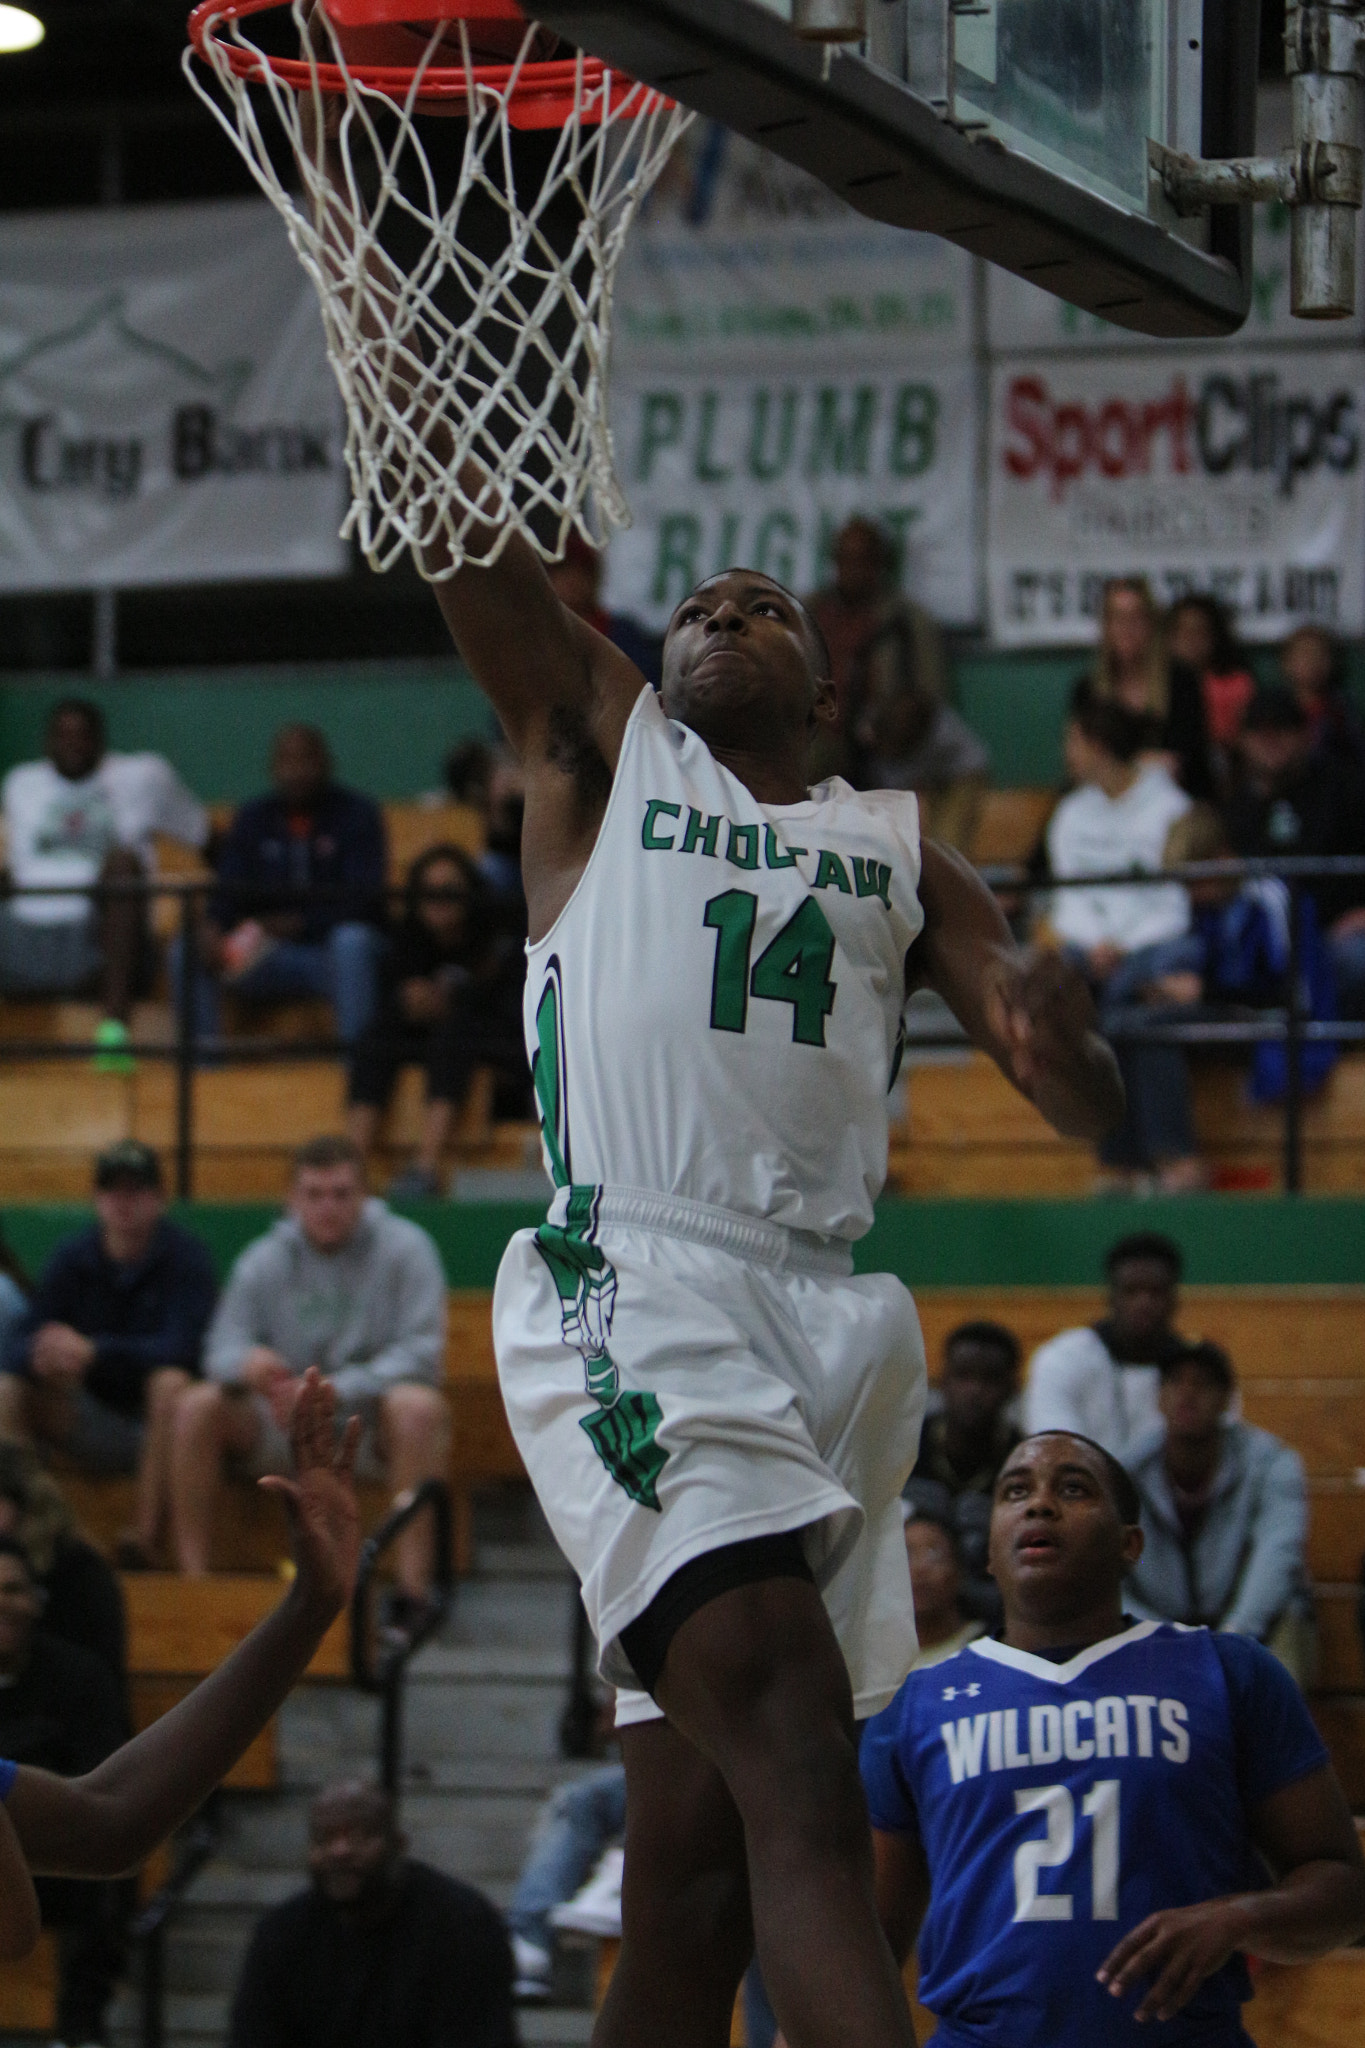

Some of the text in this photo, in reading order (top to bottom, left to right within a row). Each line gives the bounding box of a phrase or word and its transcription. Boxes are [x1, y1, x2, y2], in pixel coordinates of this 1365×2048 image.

[636, 380, 940, 485] PLUMB
[703, 887, 838, 1049] 14
[940, 1694, 1191, 1785] WILDCATS
[1011, 1778, 1121, 1924] 21
